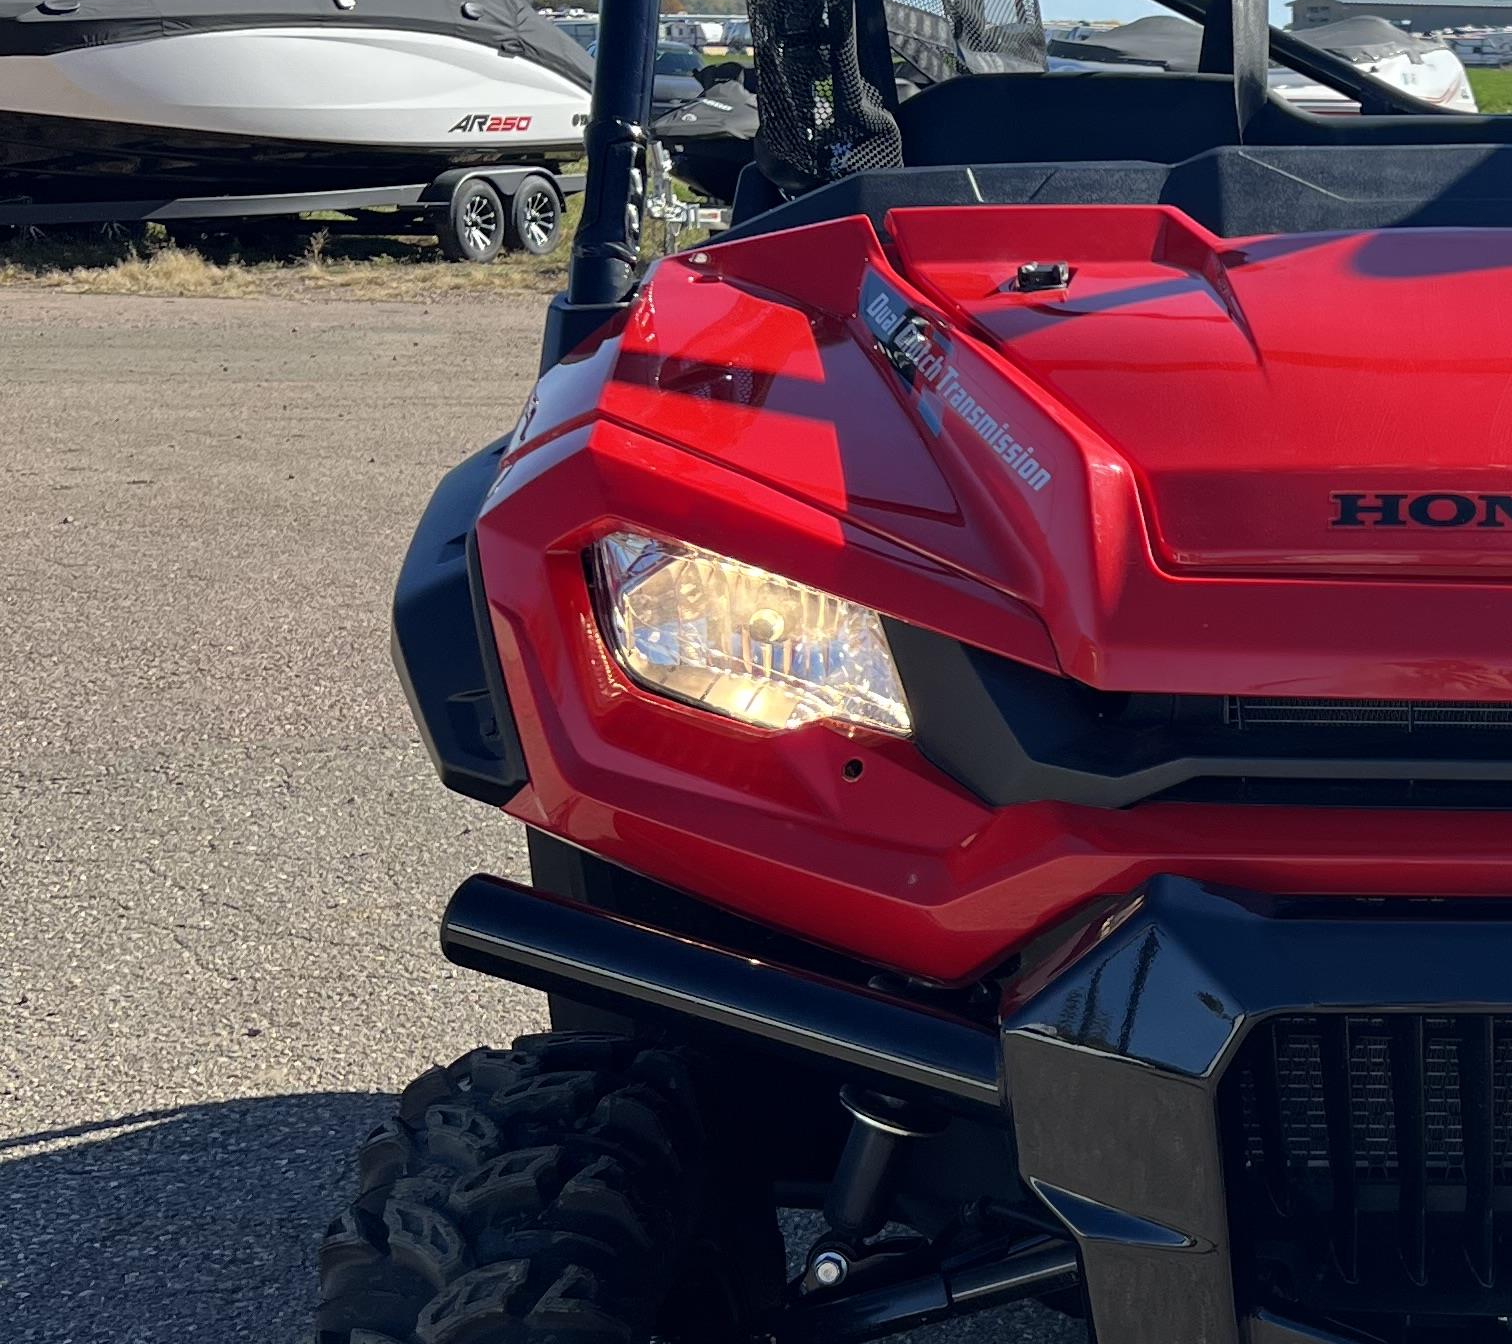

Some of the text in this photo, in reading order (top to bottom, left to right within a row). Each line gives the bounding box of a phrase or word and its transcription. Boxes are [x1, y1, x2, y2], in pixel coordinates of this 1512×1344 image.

[448, 114, 532, 132] AR250
[866, 293, 1051, 492] Dual Clutch Transmission
